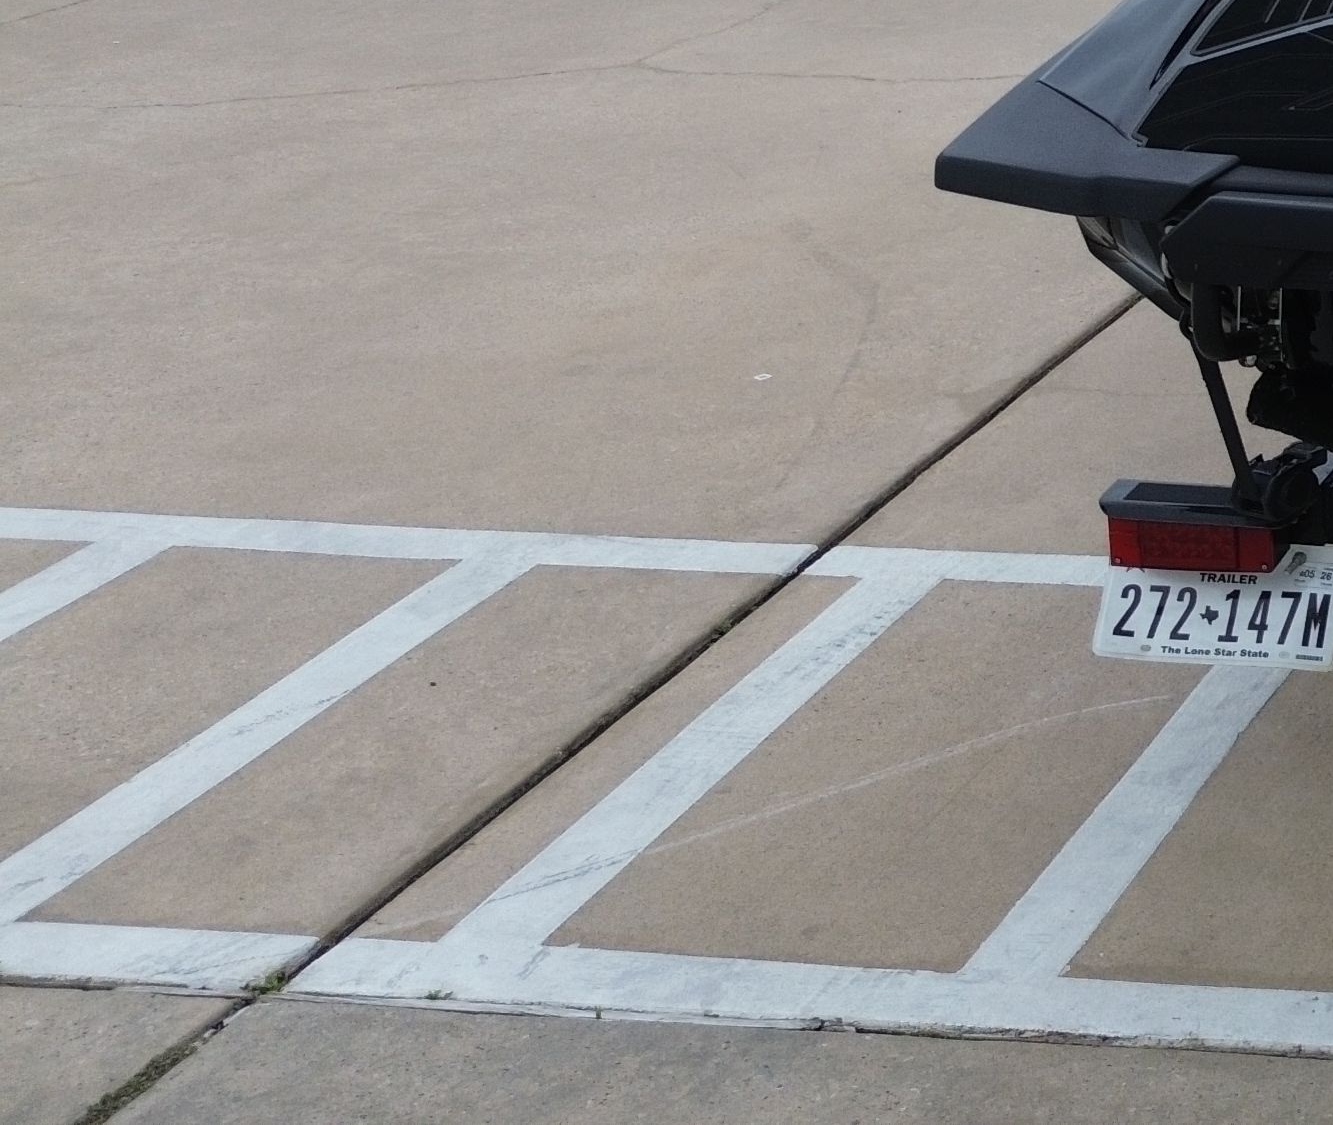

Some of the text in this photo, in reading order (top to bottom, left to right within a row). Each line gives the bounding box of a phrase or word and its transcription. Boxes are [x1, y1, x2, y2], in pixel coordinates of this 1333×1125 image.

[1200, 572, 1258, 585] TRAILER
[1319, 570, 1333, 581] 26
[1112, 583, 1332, 649] 272 147M
[1160, 645, 1269, 659] The Lone Star State
